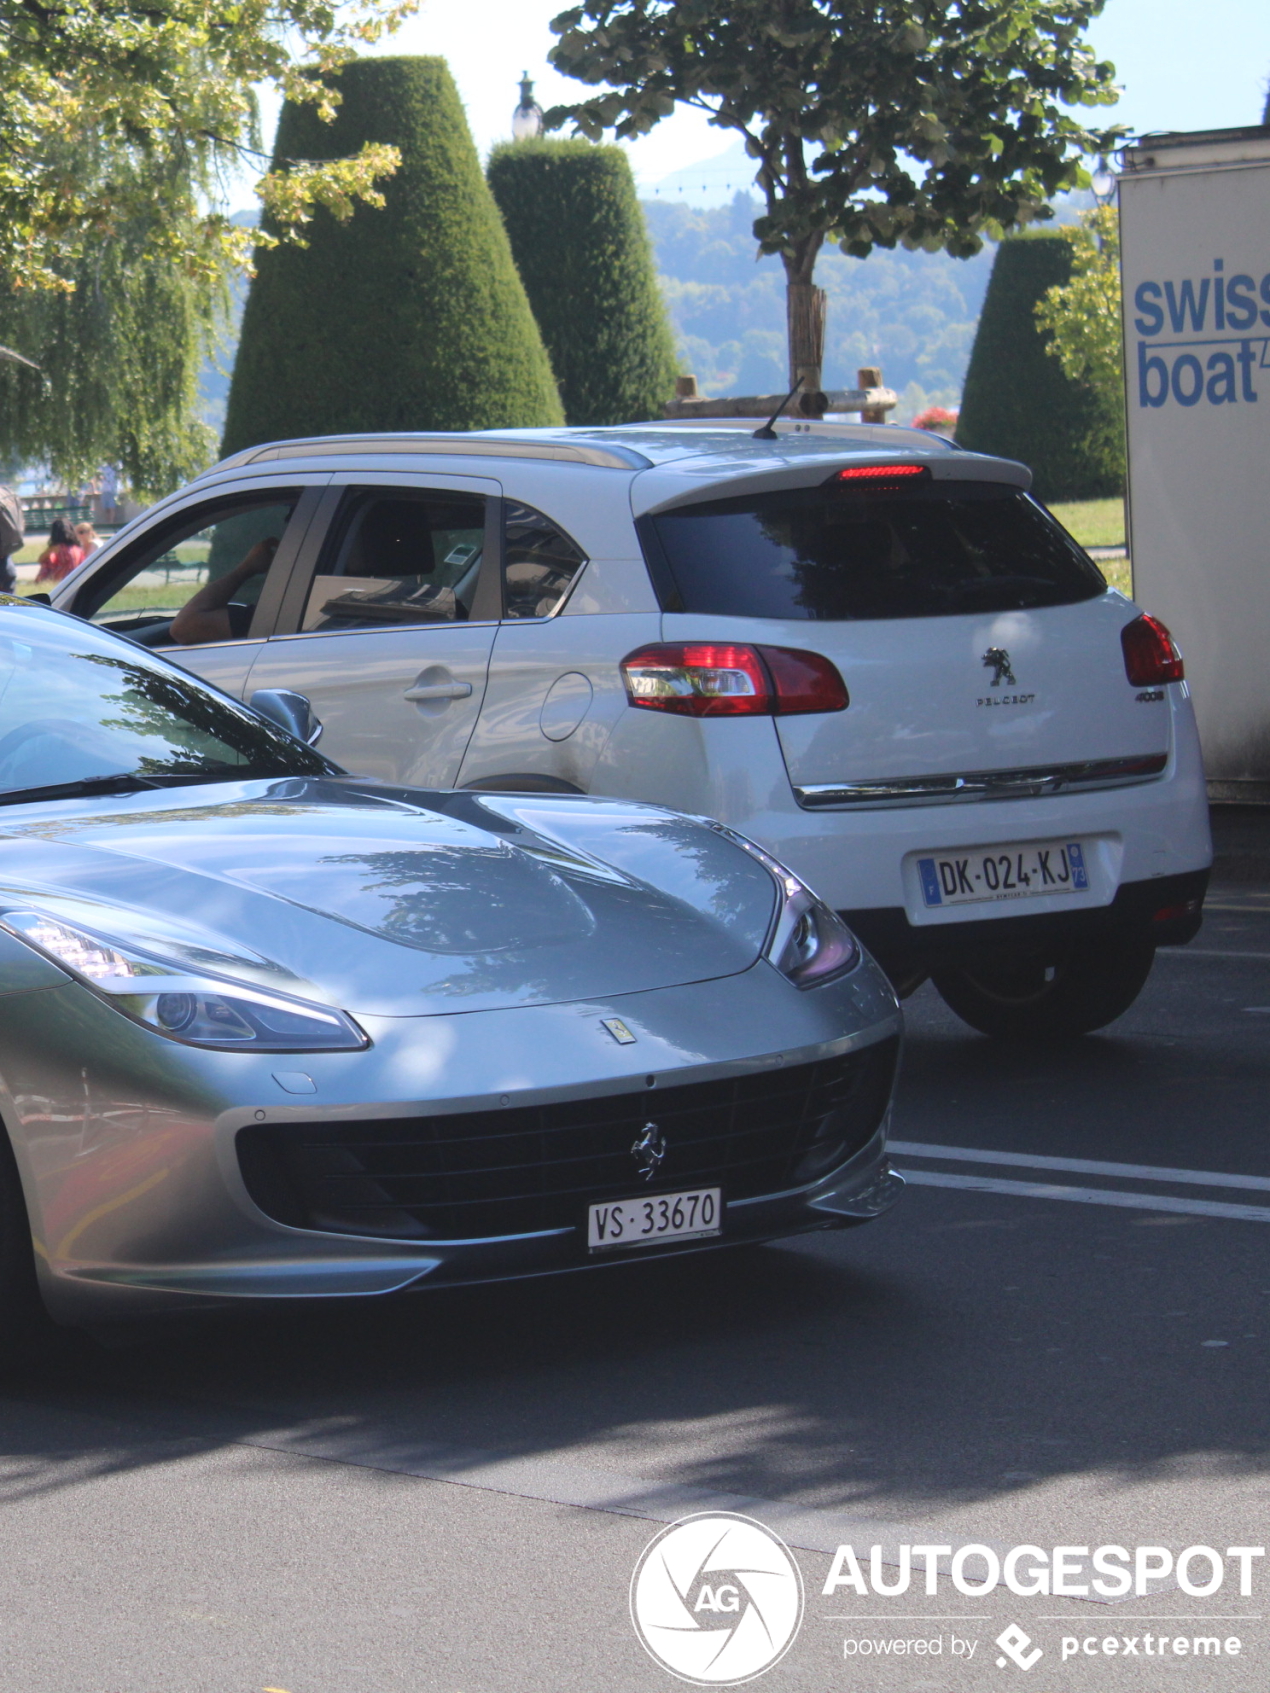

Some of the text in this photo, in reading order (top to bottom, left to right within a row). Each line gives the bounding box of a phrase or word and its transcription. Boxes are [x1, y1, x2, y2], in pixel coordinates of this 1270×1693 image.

[1137, 338, 1258, 408] boat
[939, 849, 1070, 896] DK-024-KJ
[1072, 866, 1086, 883] 73
[595, 1193, 715, 1240] VS 33670
